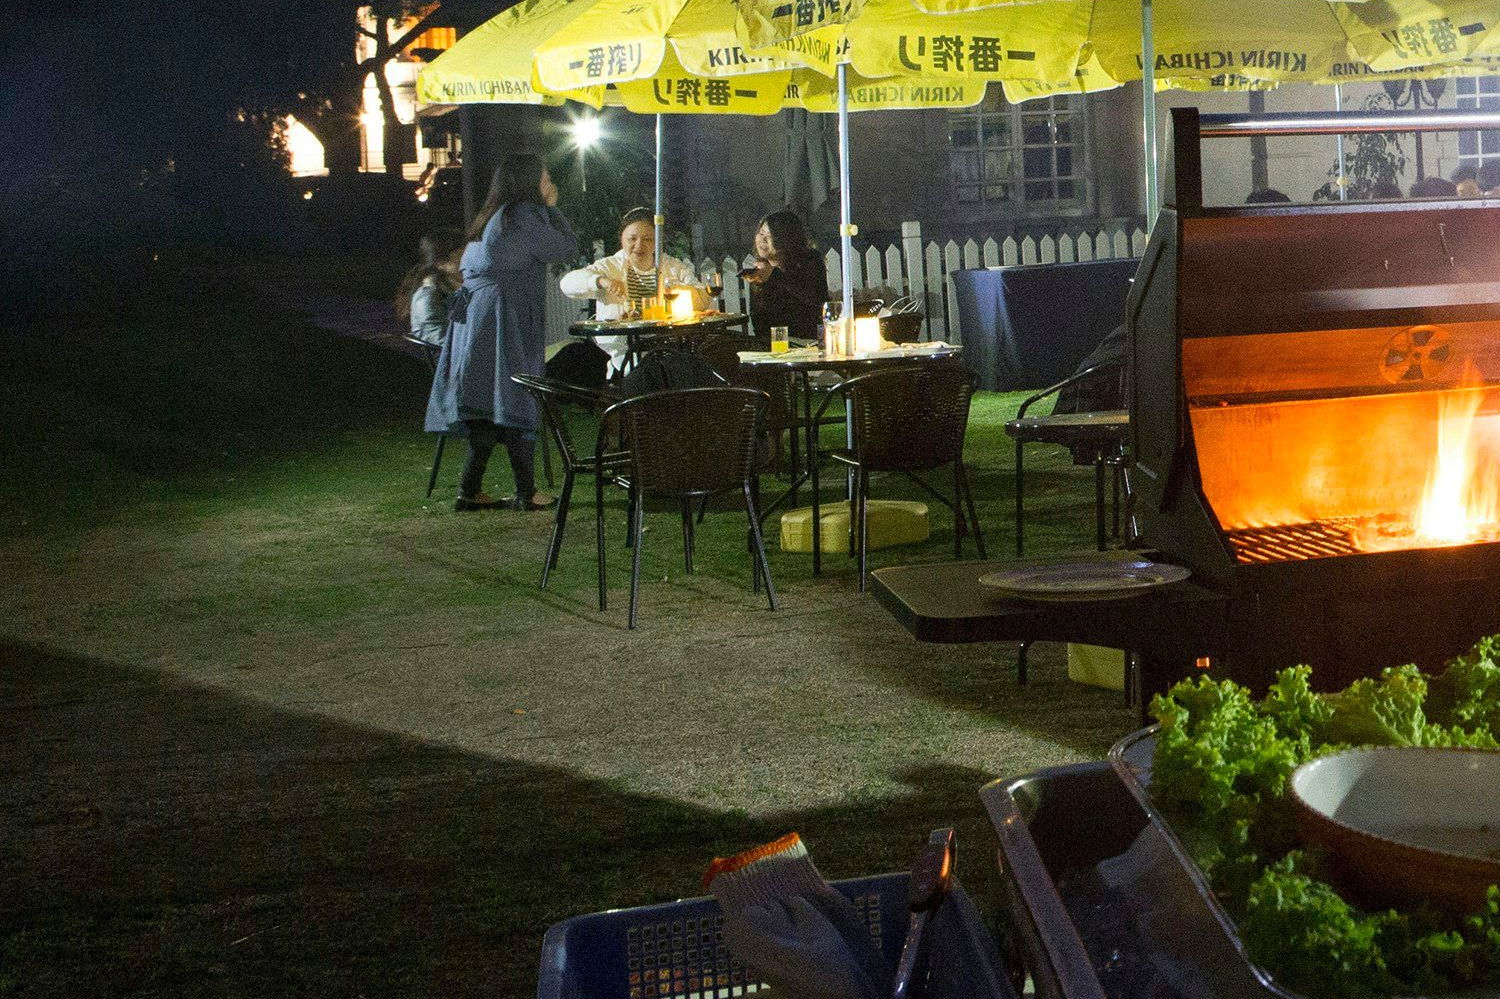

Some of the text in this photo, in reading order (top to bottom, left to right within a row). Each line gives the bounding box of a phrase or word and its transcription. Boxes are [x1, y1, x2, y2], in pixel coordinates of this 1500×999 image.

[568, 43, 642, 78] 一番搾り
[1329, 62, 1359, 77] RIN
[442, 80, 531, 97] KIRIN ICHIBAN
